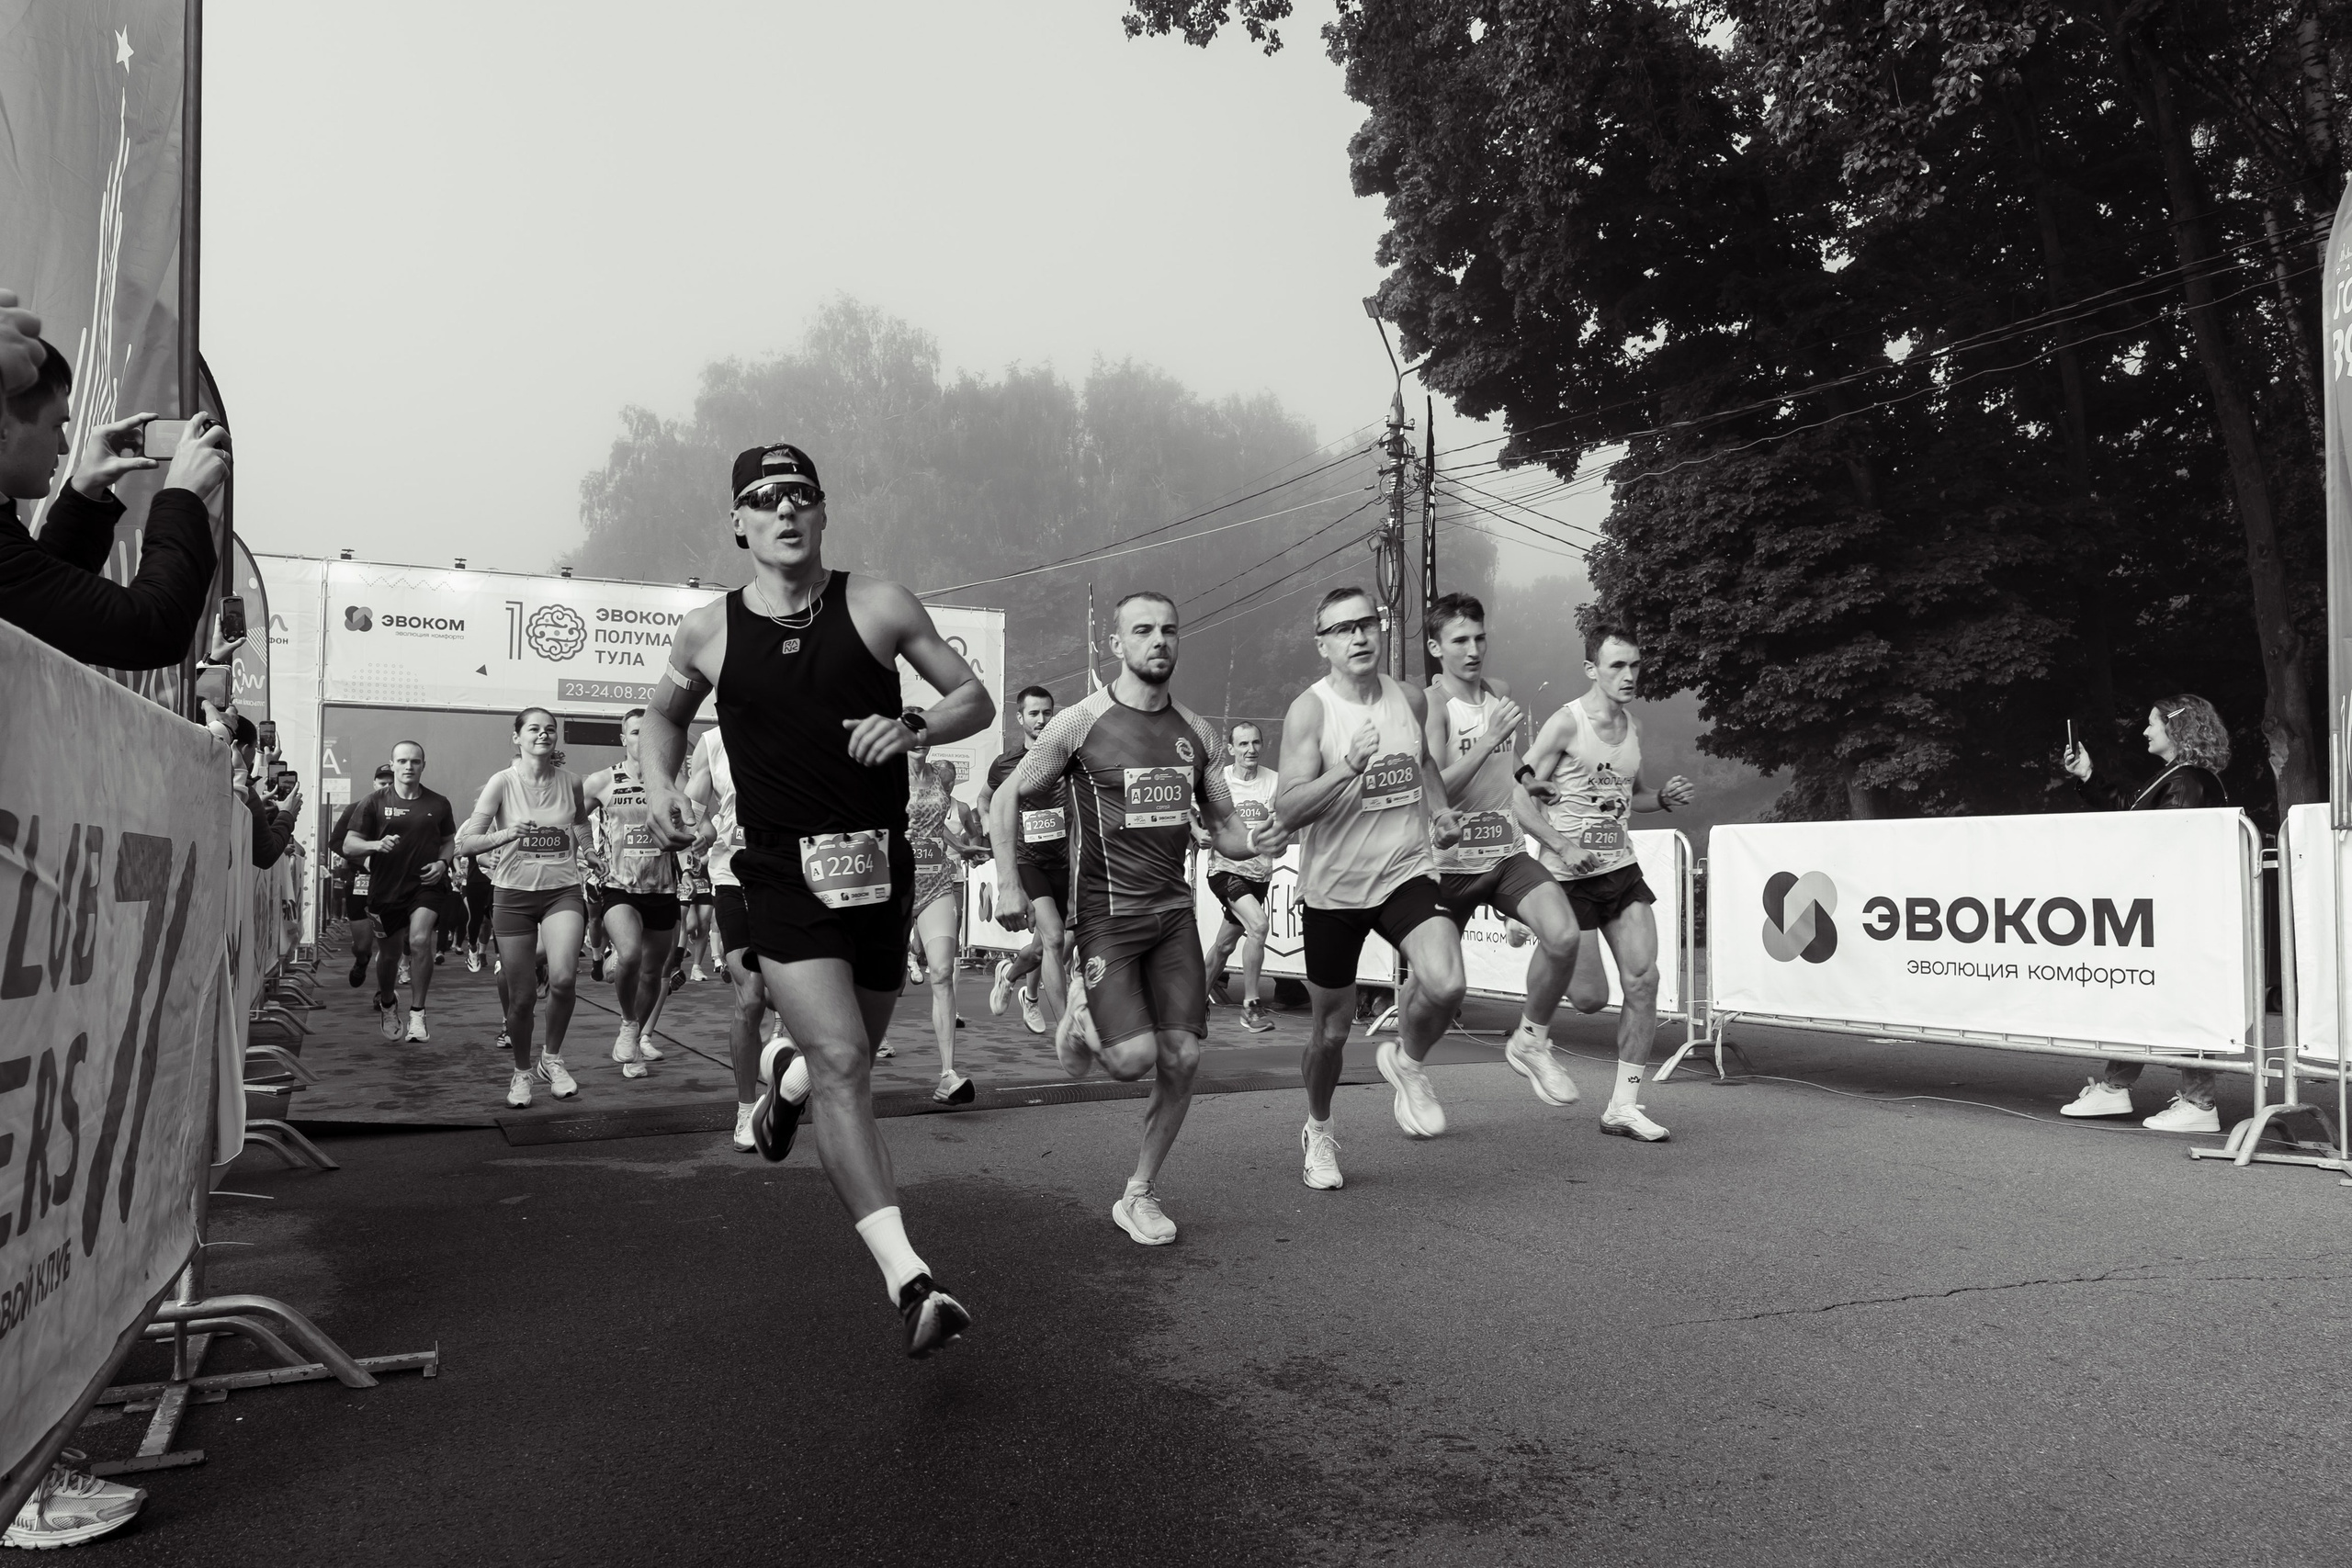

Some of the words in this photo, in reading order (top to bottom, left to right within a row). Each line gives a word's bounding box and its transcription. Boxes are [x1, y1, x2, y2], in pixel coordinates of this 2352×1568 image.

[381, 615, 464, 631] ЭВОКОМ
[595, 607, 684, 626] ЭВОКОМ
[432, 632, 464, 640] комфорта
[594, 629, 673, 647] ПОЛУМА
[594, 649, 645, 667] ТУЛА
[565, 683, 655, 701] 23-24.08.20
[1378, 766, 1413, 787] 2028
[1144, 785, 1182, 803] 2003
[1239, 808, 1261, 818] 2014
[1033, 818, 1056, 829] 2265
[1474, 824, 1502, 840] 2319
[531, 836, 560, 846] 2008
[636, 835, 652, 844] 22
[1595, 831, 1617, 843] 2161
[827, 853, 874, 877] 2264
[1861, 896, 2154, 949] ЭВОКОМ
[1463, 930, 1483, 942] ппа
[1906, 959, 2018, 981] эволюция
[2028, 961, 2155, 988] комфорта
[0, 1264, 33, 1340] ВОЙ
[35, 1236, 71, 1307] КЛУБ
